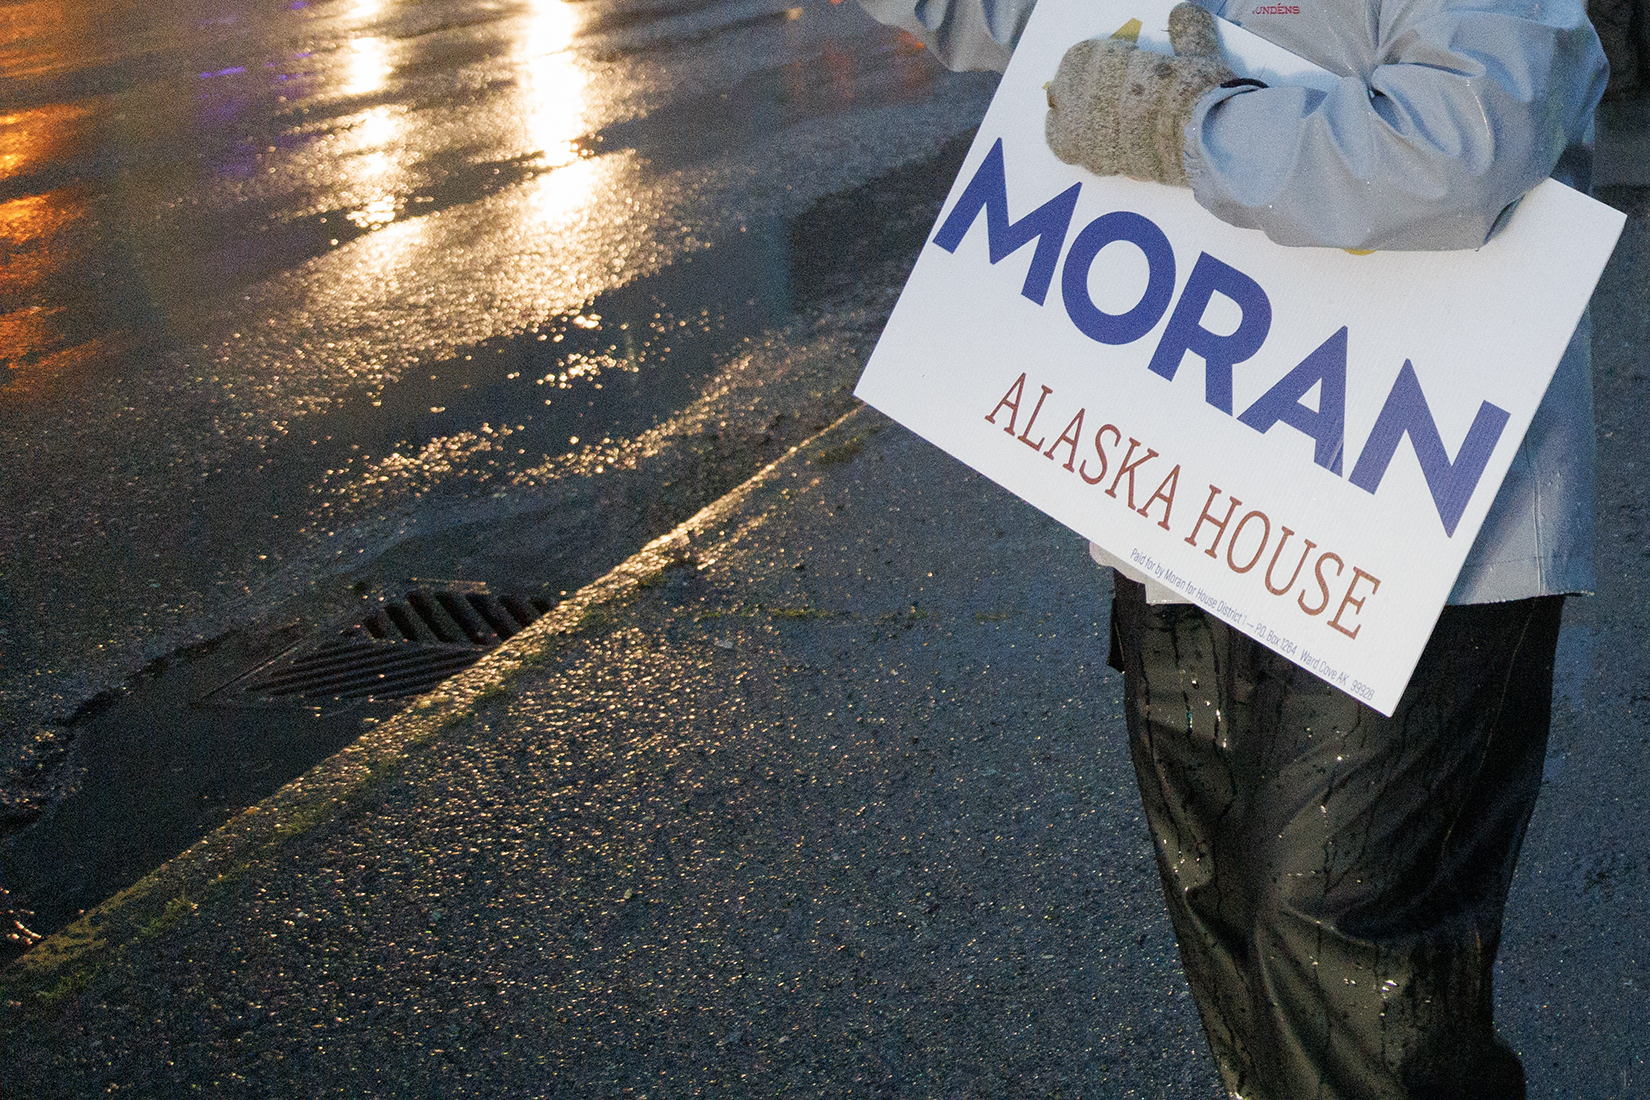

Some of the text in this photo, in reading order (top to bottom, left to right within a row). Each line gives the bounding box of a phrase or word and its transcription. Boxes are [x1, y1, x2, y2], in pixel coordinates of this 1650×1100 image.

[932, 137, 1511, 538] MORAN
[984, 372, 1381, 641] ALASKA HOUSE
[1130, 548, 1147, 565] Paid
[1144, 557, 1155, 571] for
[1155, 562, 1165, 579] by
[1164, 568, 1186, 590] Moran
[1185, 581, 1196, 596] for
[1196, 587, 1218, 609] House
[1217, 600, 1243, 624] District
[1254, 622, 1266, 639] P.O.
[1266, 630, 1279, 646] Box
[1279, 638, 1298, 656] 1264
[1300, 649, 1321, 670] Ward
[1319, 661, 1338, 680] Cove
[1336, 672, 1350, 686] AK
[1351, 679, 1376, 701] 99928
